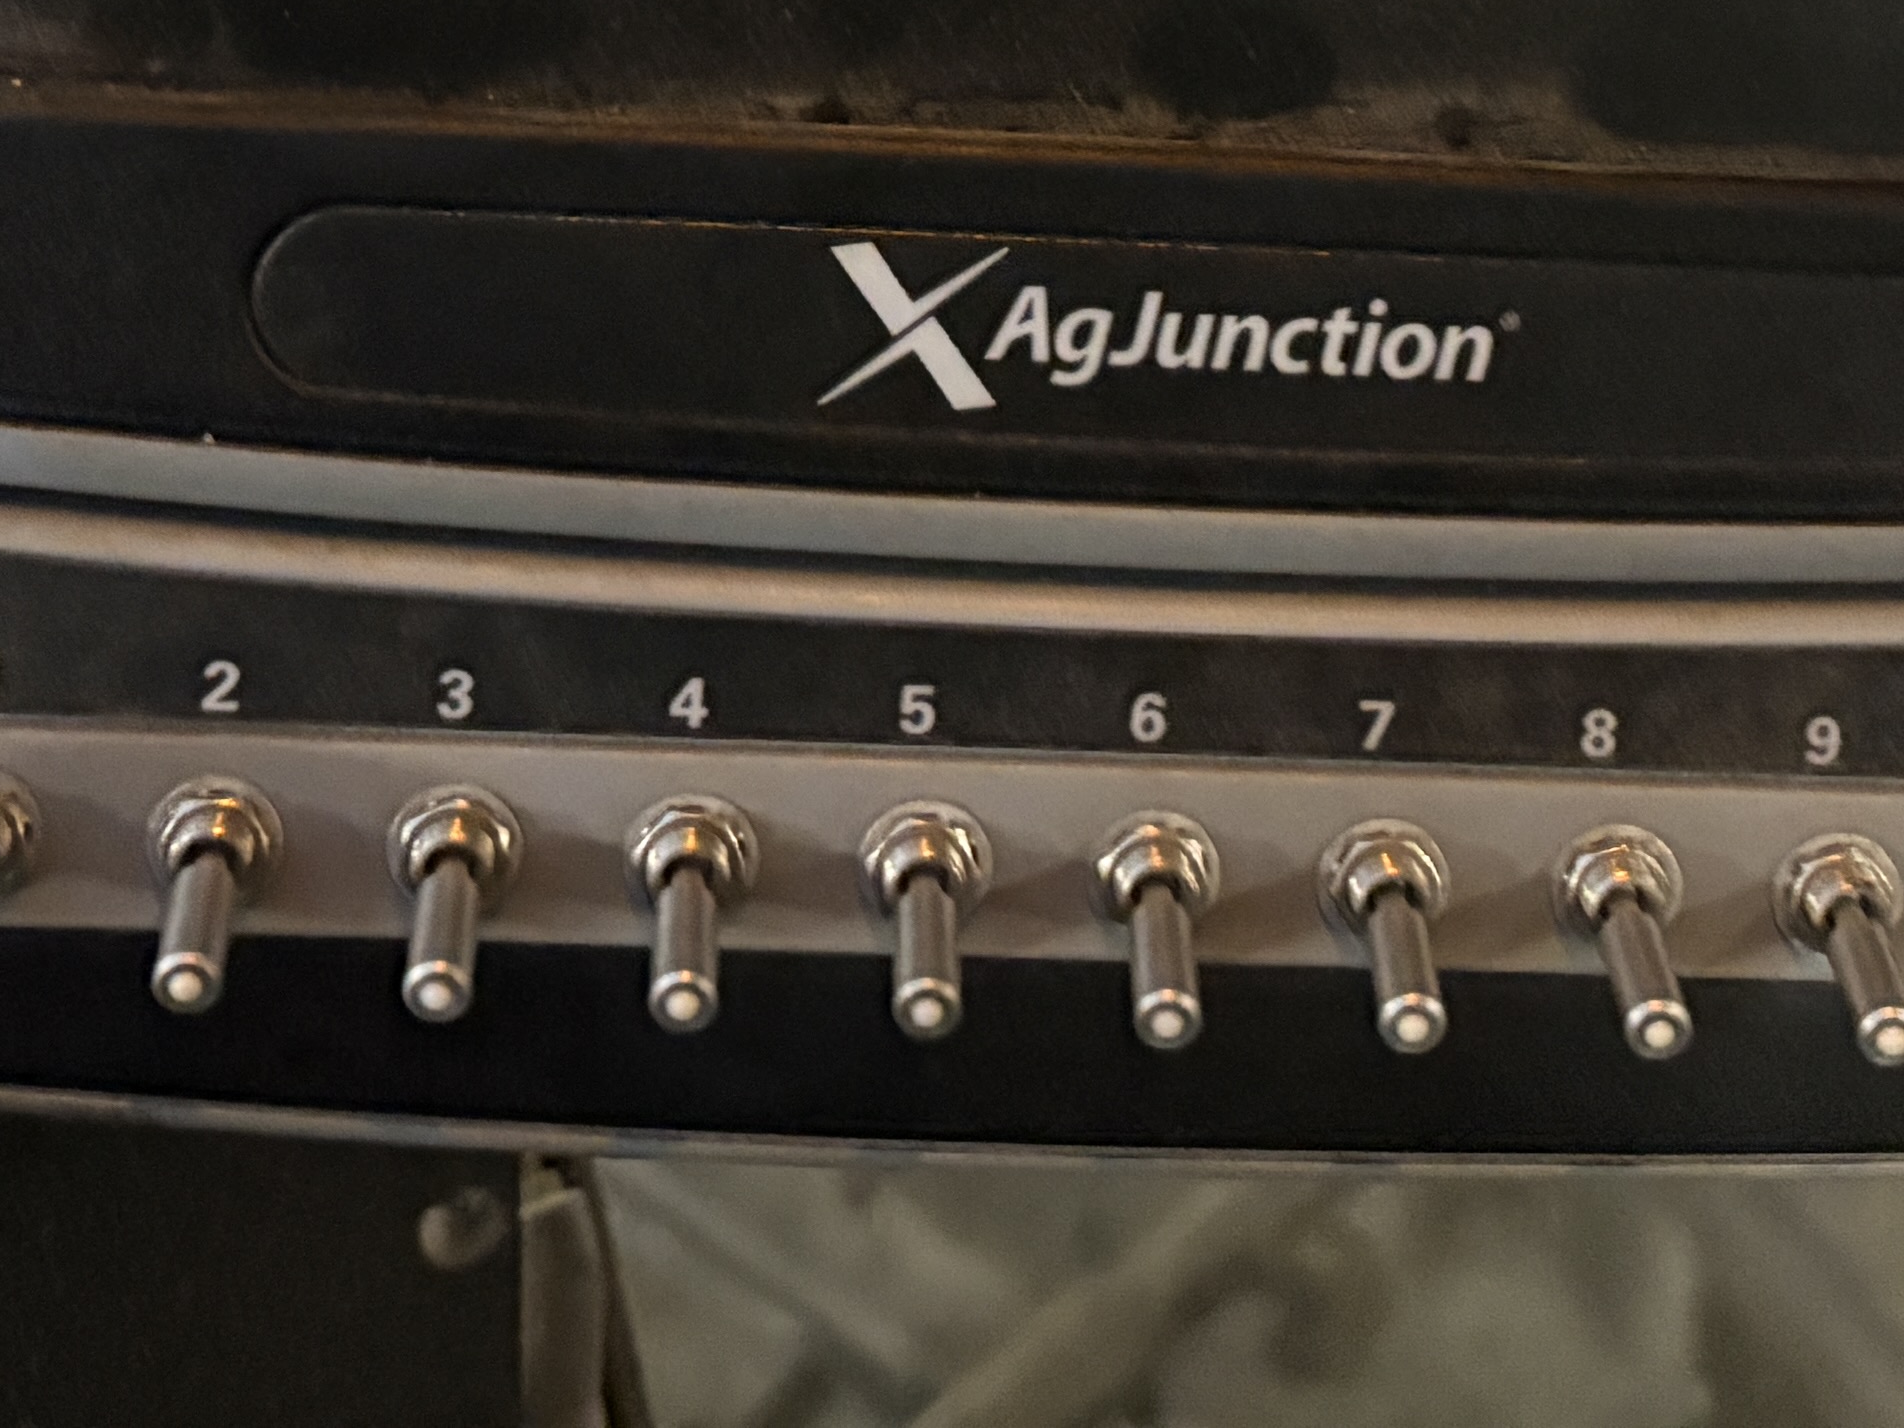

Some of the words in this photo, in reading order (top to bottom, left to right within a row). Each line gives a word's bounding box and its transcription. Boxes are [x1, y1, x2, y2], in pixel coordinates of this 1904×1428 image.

[983, 283, 1496, 388] AgJunction
[199, 659, 242, 713] 2
[436, 668, 475, 721] 3
[668, 676, 710, 730] 4
[898, 683, 937, 736] 5
[1128, 691, 1168, 744] 6
[1358, 698, 1397, 752] 7
[1579, 707, 1619, 759] 8
[1804, 715, 1843, 767] 9
